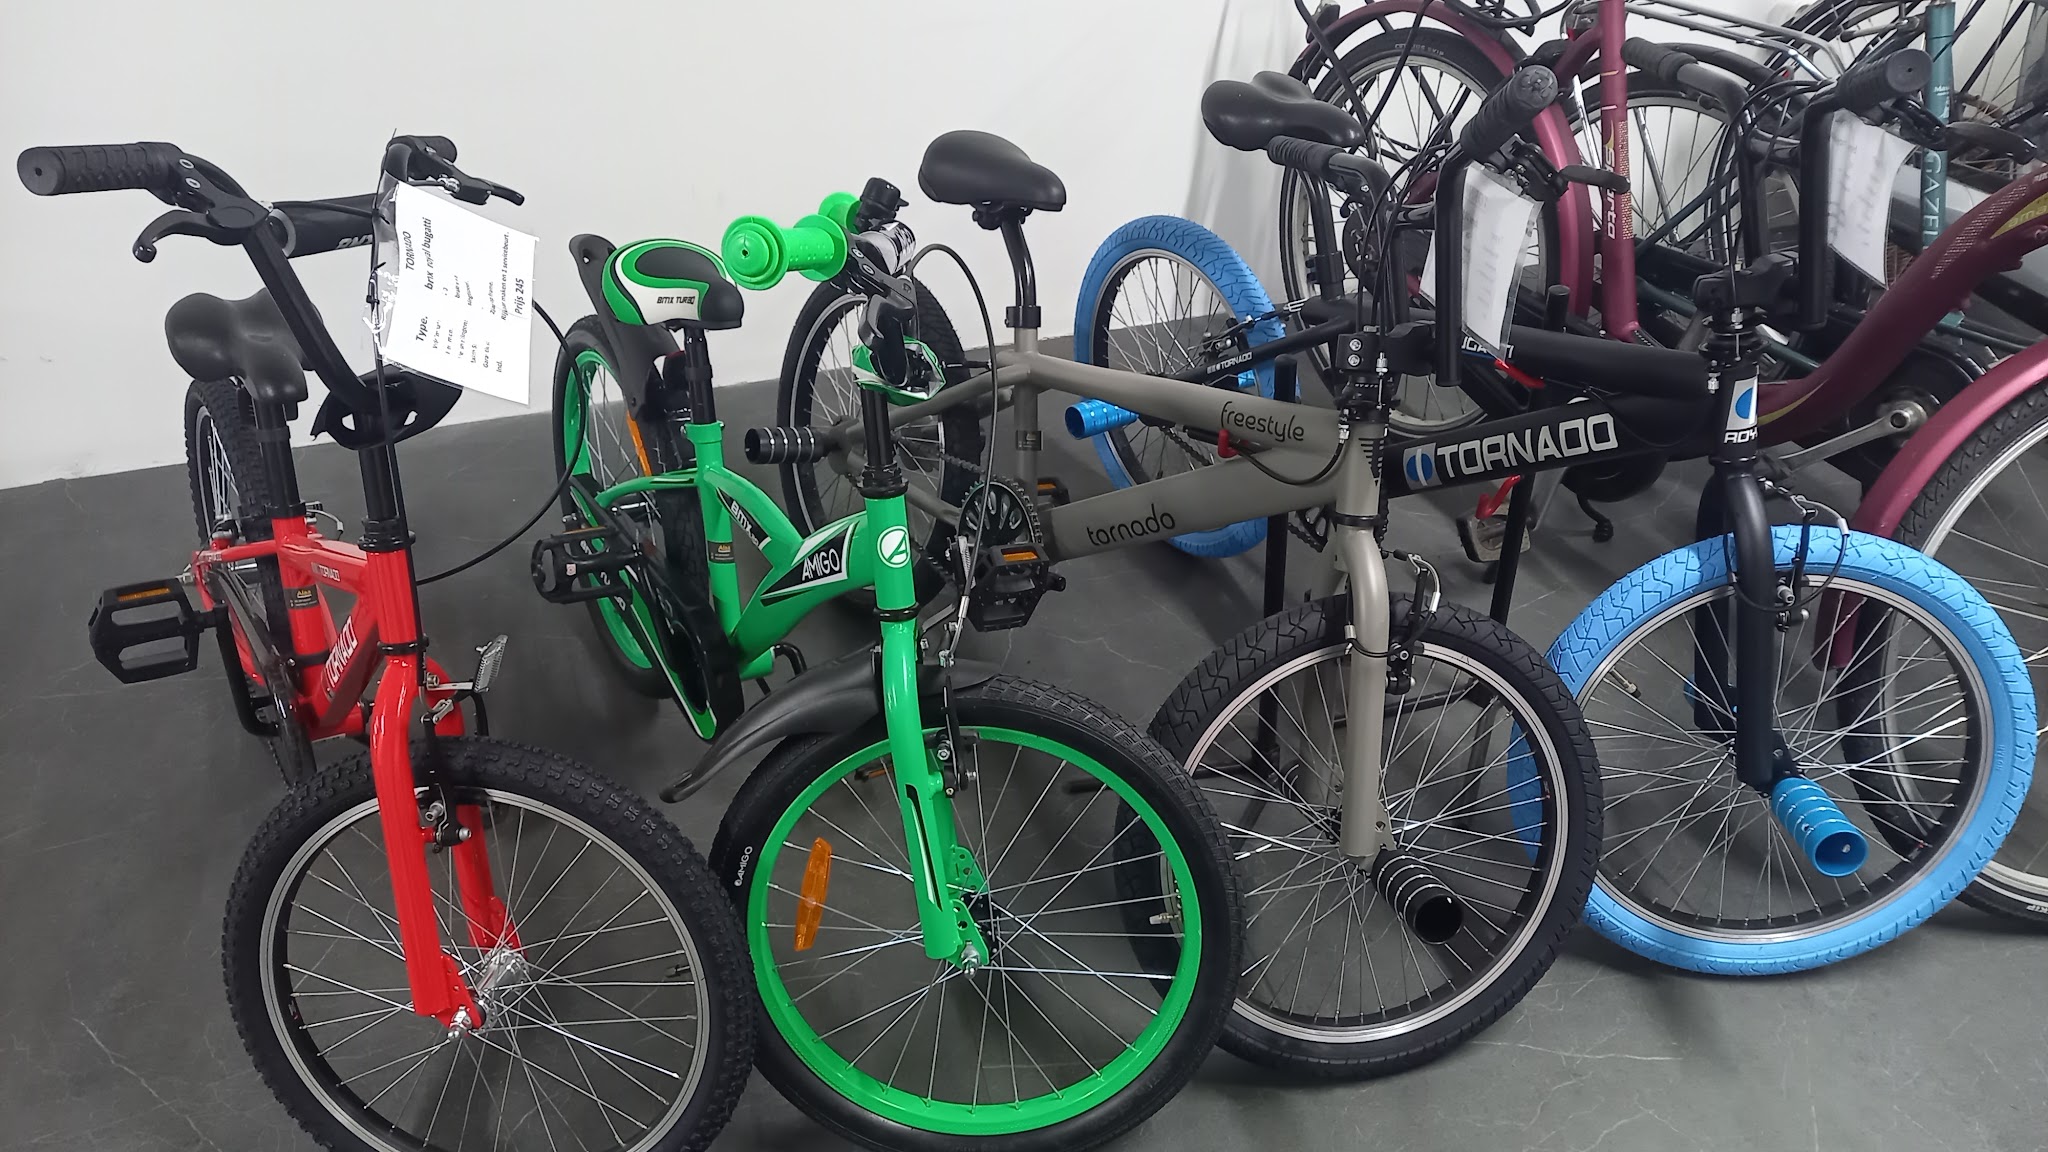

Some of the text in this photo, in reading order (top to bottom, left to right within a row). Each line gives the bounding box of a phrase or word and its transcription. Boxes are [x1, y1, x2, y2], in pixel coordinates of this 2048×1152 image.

[1605, 147, 1616, 239] Sarta
[1922, 149, 1942, 249] GAZEL
[422, 217, 434, 248] bugatti
[514, 277, 525, 315] Prijs 245
[656, 296, 674, 304] BMX
[1220, 351, 1253, 370] TORNADO
[1220, 400, 1305, 442] freestyle
[1437, 412, 1619, 478] TORNADO
[1086, 503, 1176, 546] tornado
[801, 548, 840, 581] AMIGO
[325, 615, 359, 689] TORNADO
[736, 845, 753, 881] AMIGO
